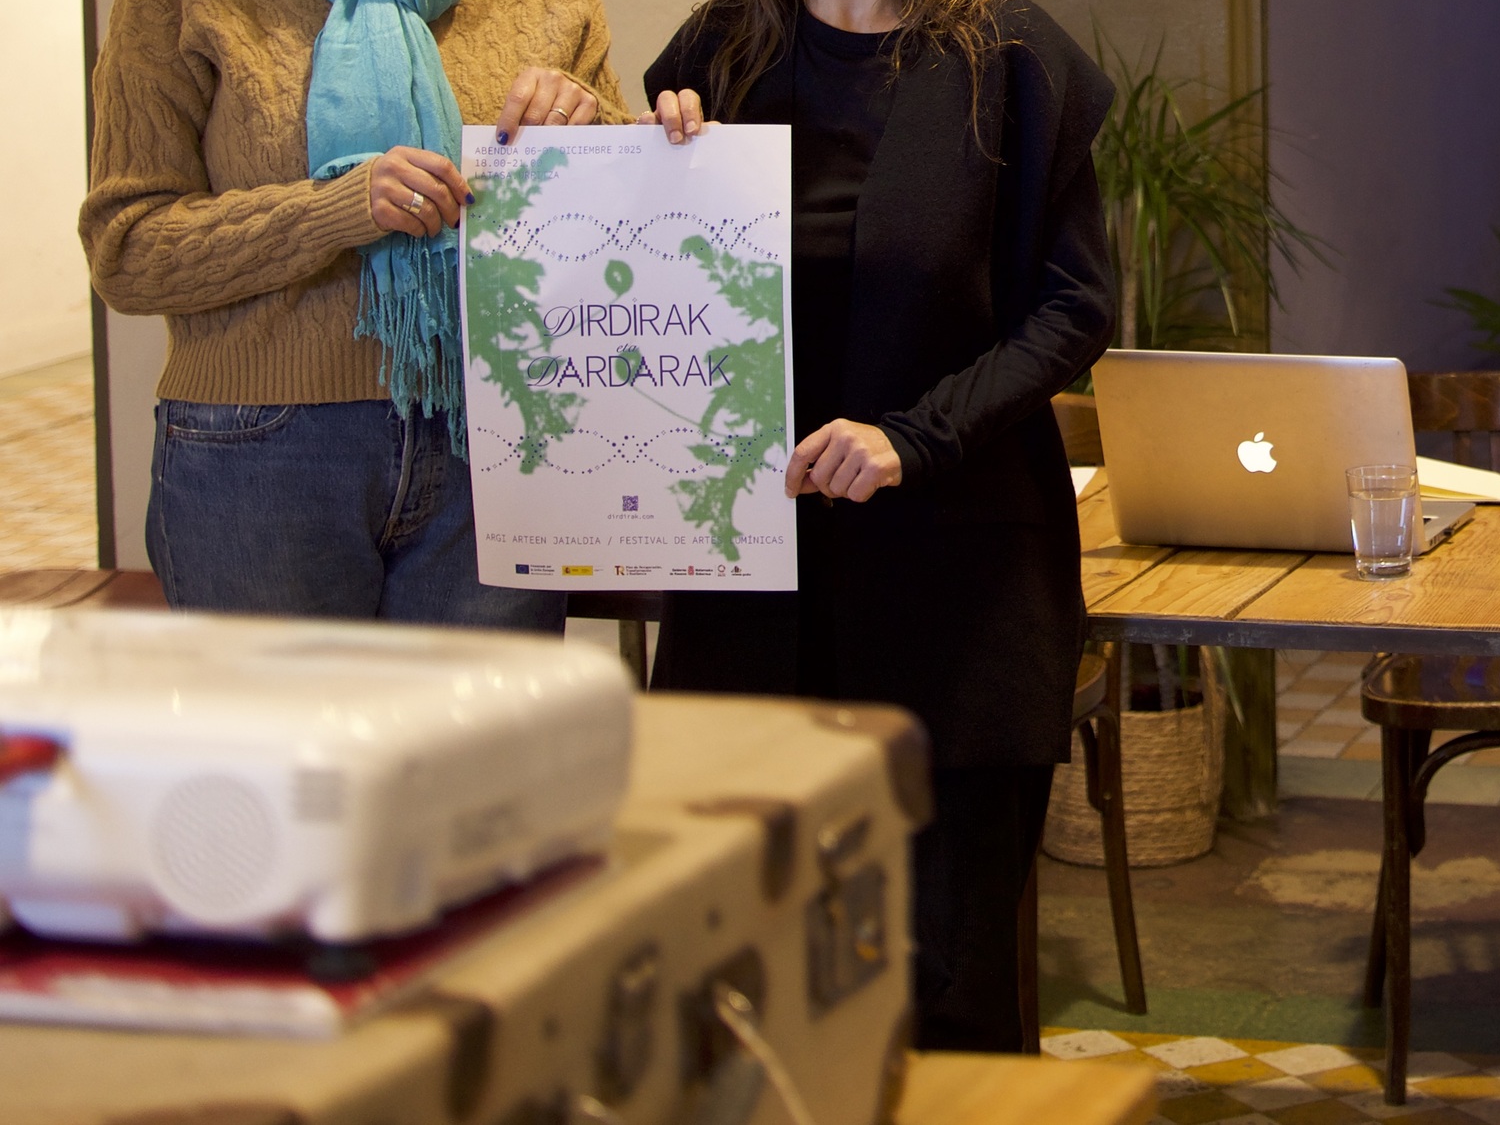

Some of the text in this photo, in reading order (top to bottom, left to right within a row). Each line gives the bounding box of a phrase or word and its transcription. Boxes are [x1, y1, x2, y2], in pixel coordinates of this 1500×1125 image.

[474, 146, 519, 155] ABENDUA
[559, 145, 613, 155] DICIEMBRE
[618, 145, 642, 154] 2025
[543, 302, 712, 338] DIRDIRAK
[616, 343, 639, 354] eta
[526, 355, 732, 388] DARDARAK
[486, 533, 507, 543] ARGI
[512, 535, 547, 545] ARTEEN
[553, 536, 601, 545] JAIALDIA
[619, 536, 668, 545] FESTIVAL
[674, 536, 686, 545] DE
[692, 535, 723, 545] ARTES
